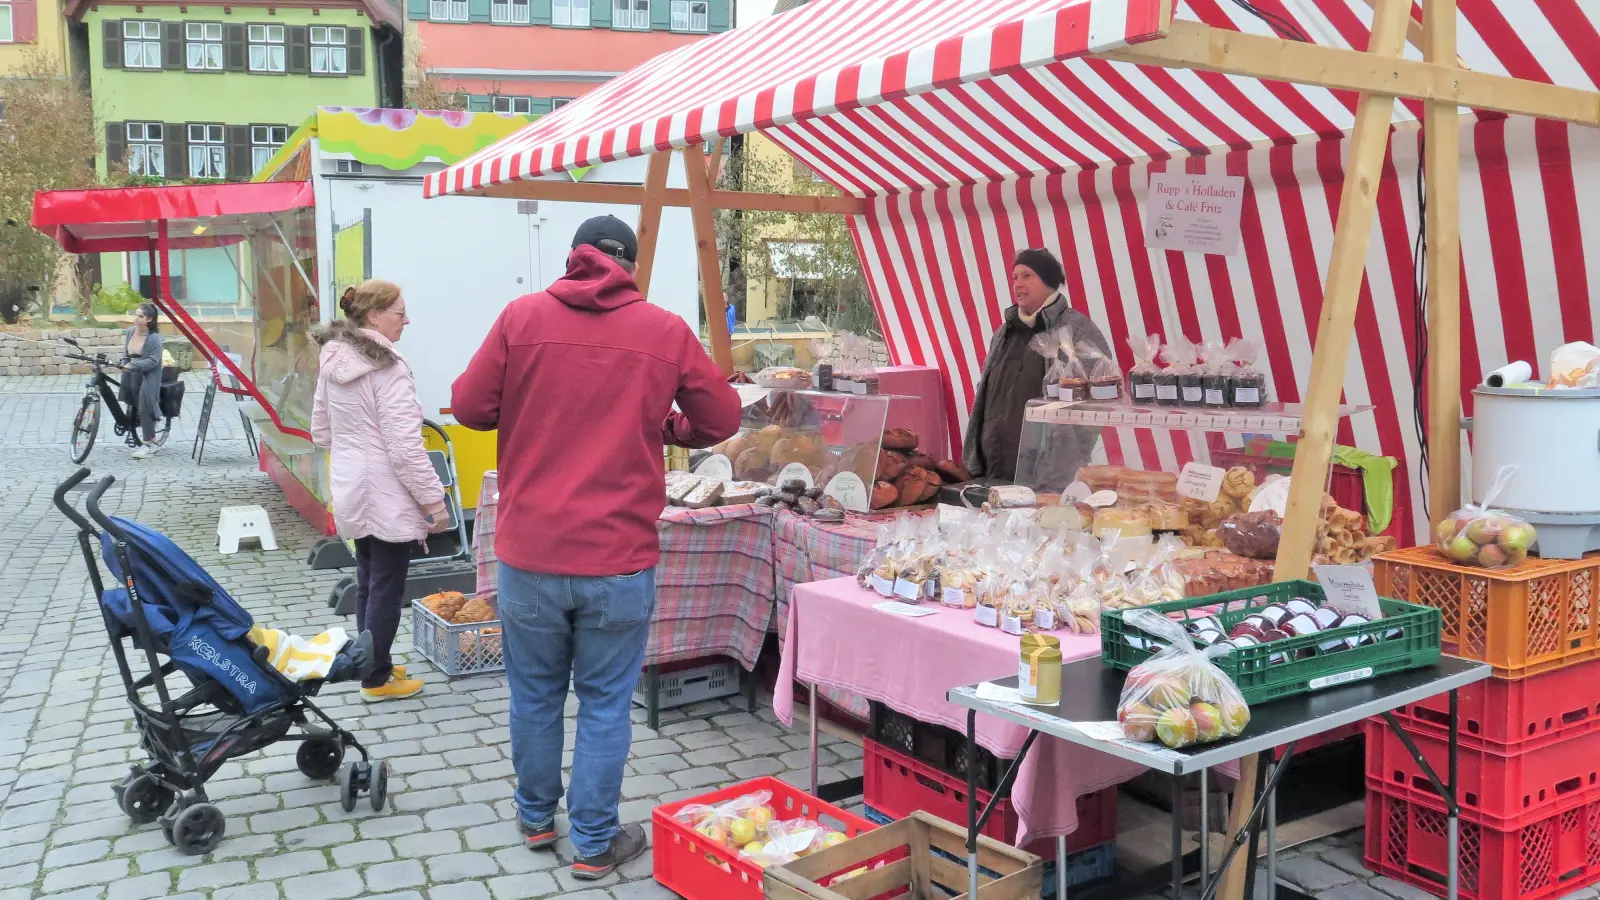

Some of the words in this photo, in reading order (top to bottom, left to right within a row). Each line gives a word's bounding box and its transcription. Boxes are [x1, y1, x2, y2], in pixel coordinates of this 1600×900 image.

[1192, 184, 1236, 198] Hofladen
[1165, 199, 1174, 210] &
[1200, 201, 1222, 214] Fritz
